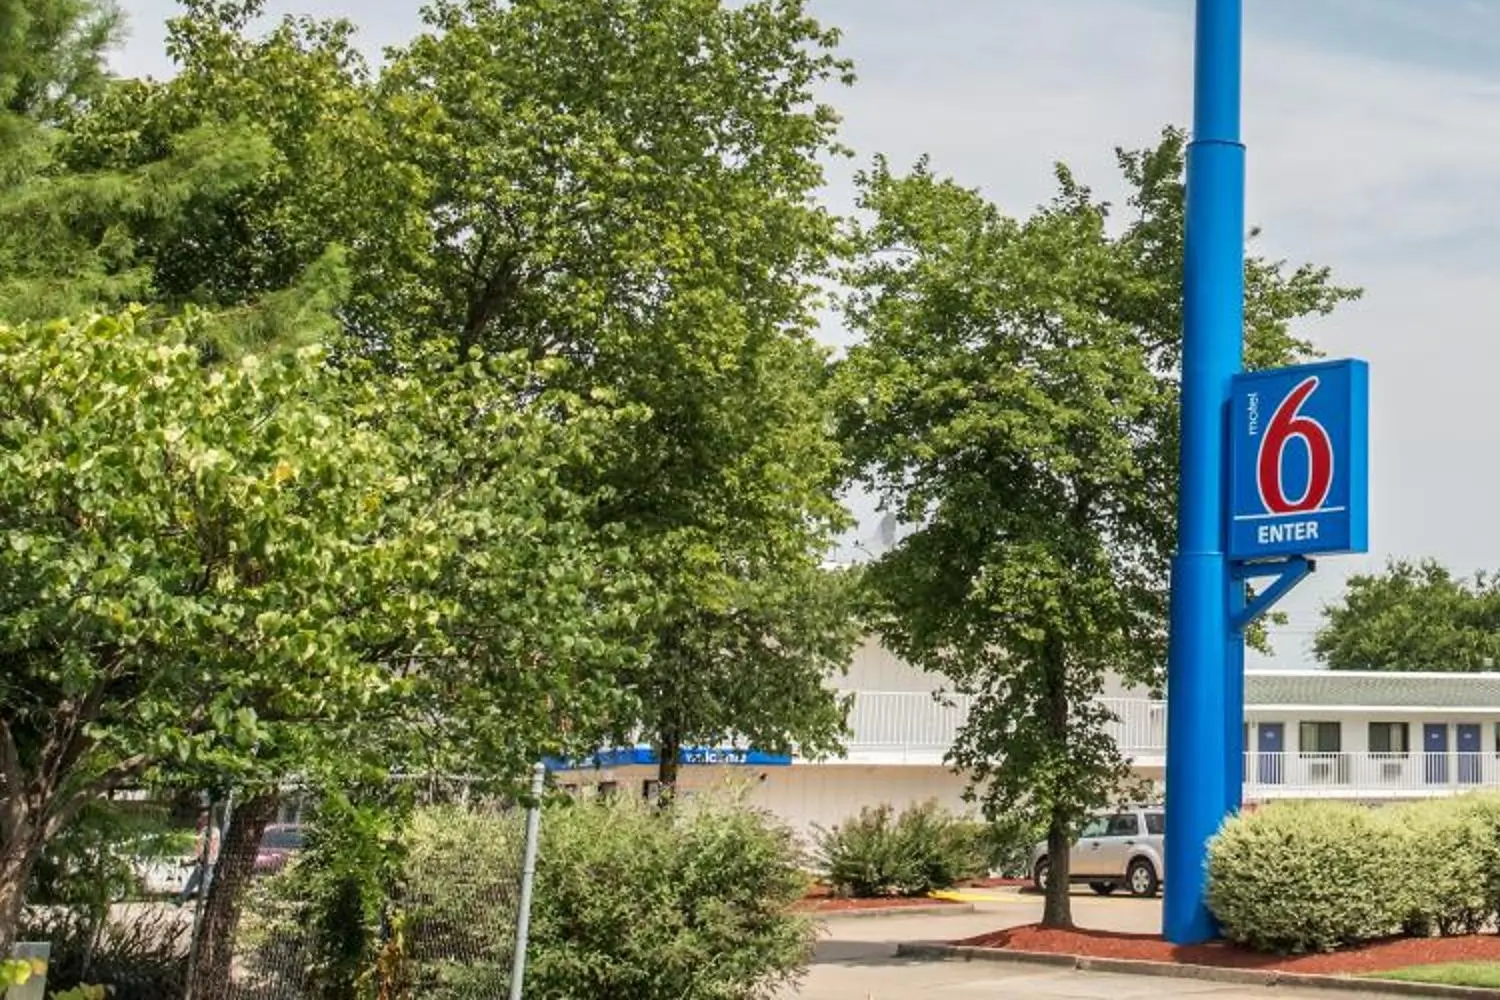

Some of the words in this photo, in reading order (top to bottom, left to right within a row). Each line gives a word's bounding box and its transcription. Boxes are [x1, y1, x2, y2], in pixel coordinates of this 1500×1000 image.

[1247, 391, 1259, 435] motel
[1256, 376, 1334, 516] 6
[1258, 521, 1319, 544] ENTER
